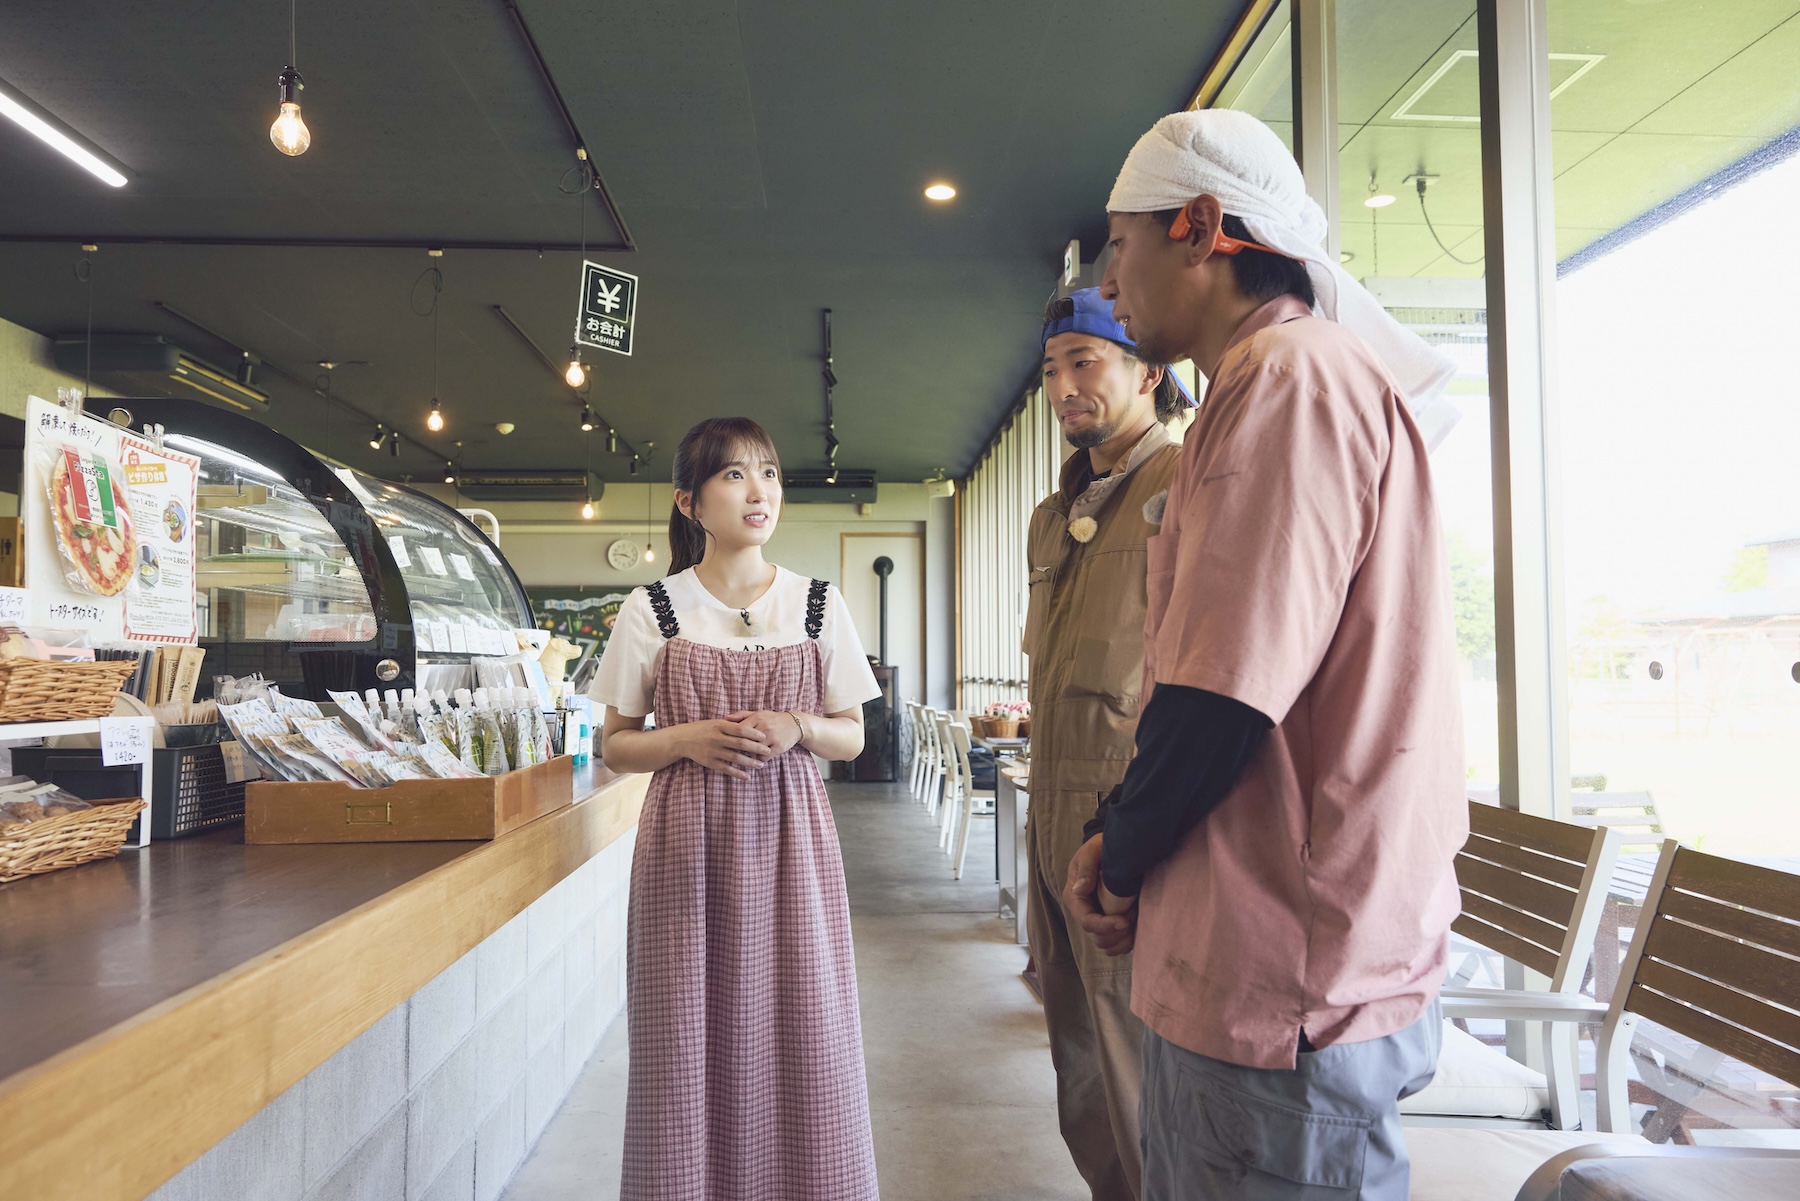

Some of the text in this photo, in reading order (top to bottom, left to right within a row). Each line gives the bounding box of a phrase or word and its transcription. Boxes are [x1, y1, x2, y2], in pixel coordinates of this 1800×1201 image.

[597, 278, 622, 313] ¥
[586, 317, 626, 340] お会計
[590, 333, 620, 348] CASHIER
